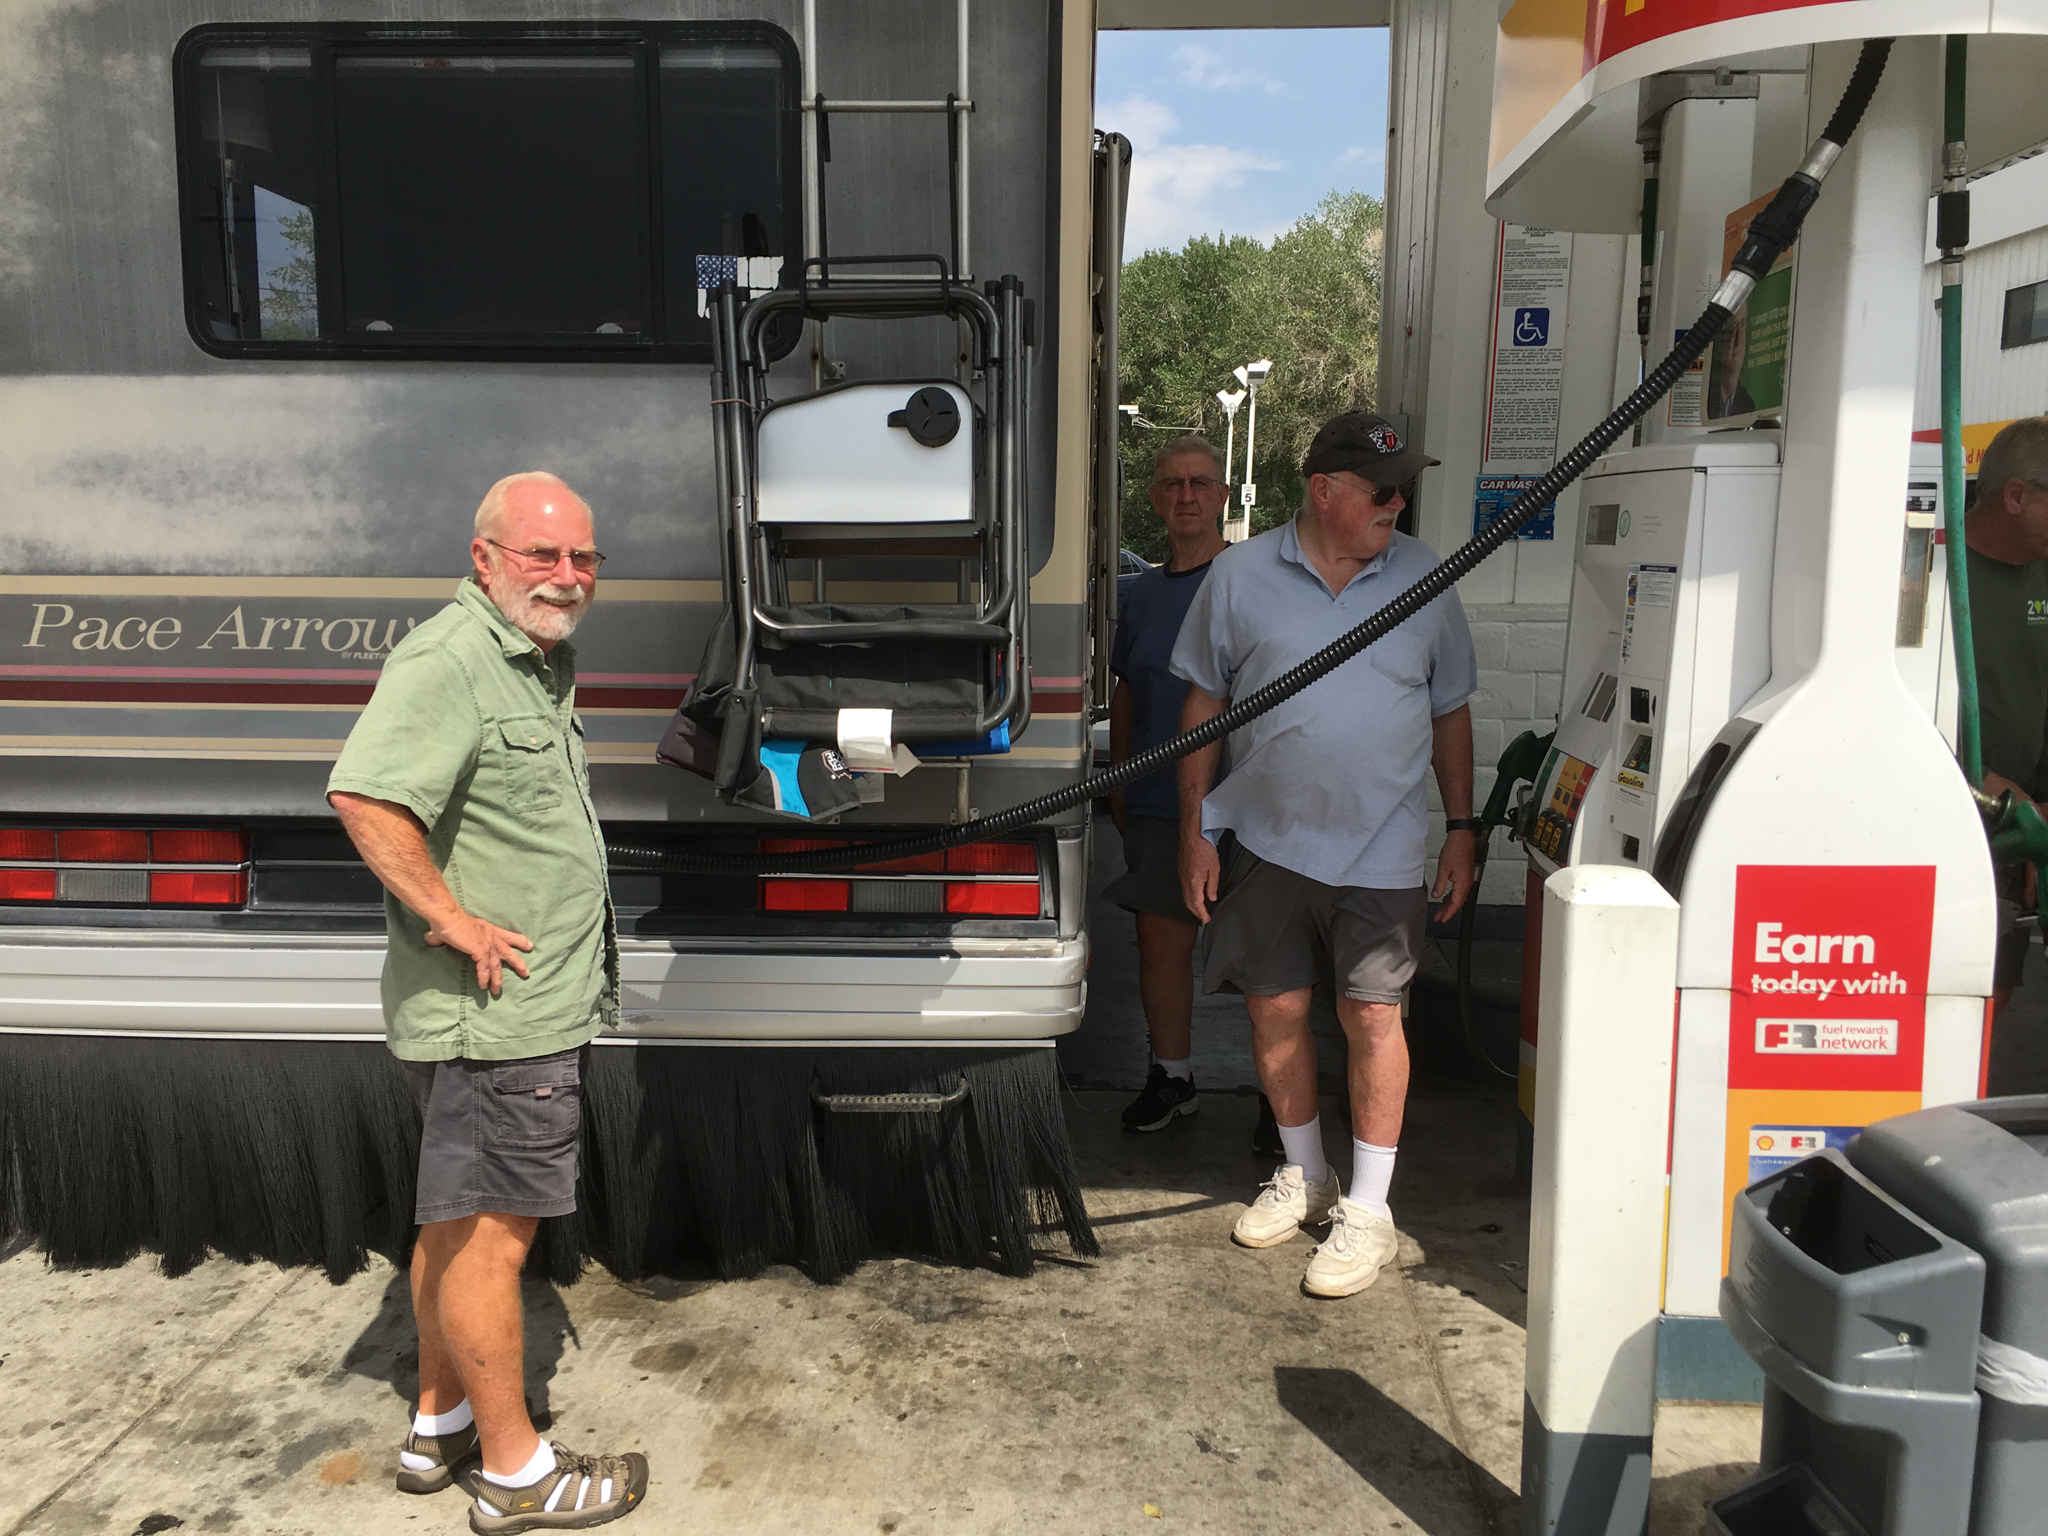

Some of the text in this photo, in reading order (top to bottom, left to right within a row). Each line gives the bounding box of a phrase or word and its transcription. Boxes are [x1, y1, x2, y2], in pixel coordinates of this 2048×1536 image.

[1479, 480, 1537, 490] CAR WAS
[1245, 493, 1252, 502] 5
[22, 603, 182, 651] Pace
[1618, 772, 1645, 789] Gasoline
[1755, 922, 1875, 964] Earn
[1751, 970, 1907, 1001] today with
[1822, 1024, 1889, 1035] fuel rewards
[1821, 1036, 1889, 1050] network
